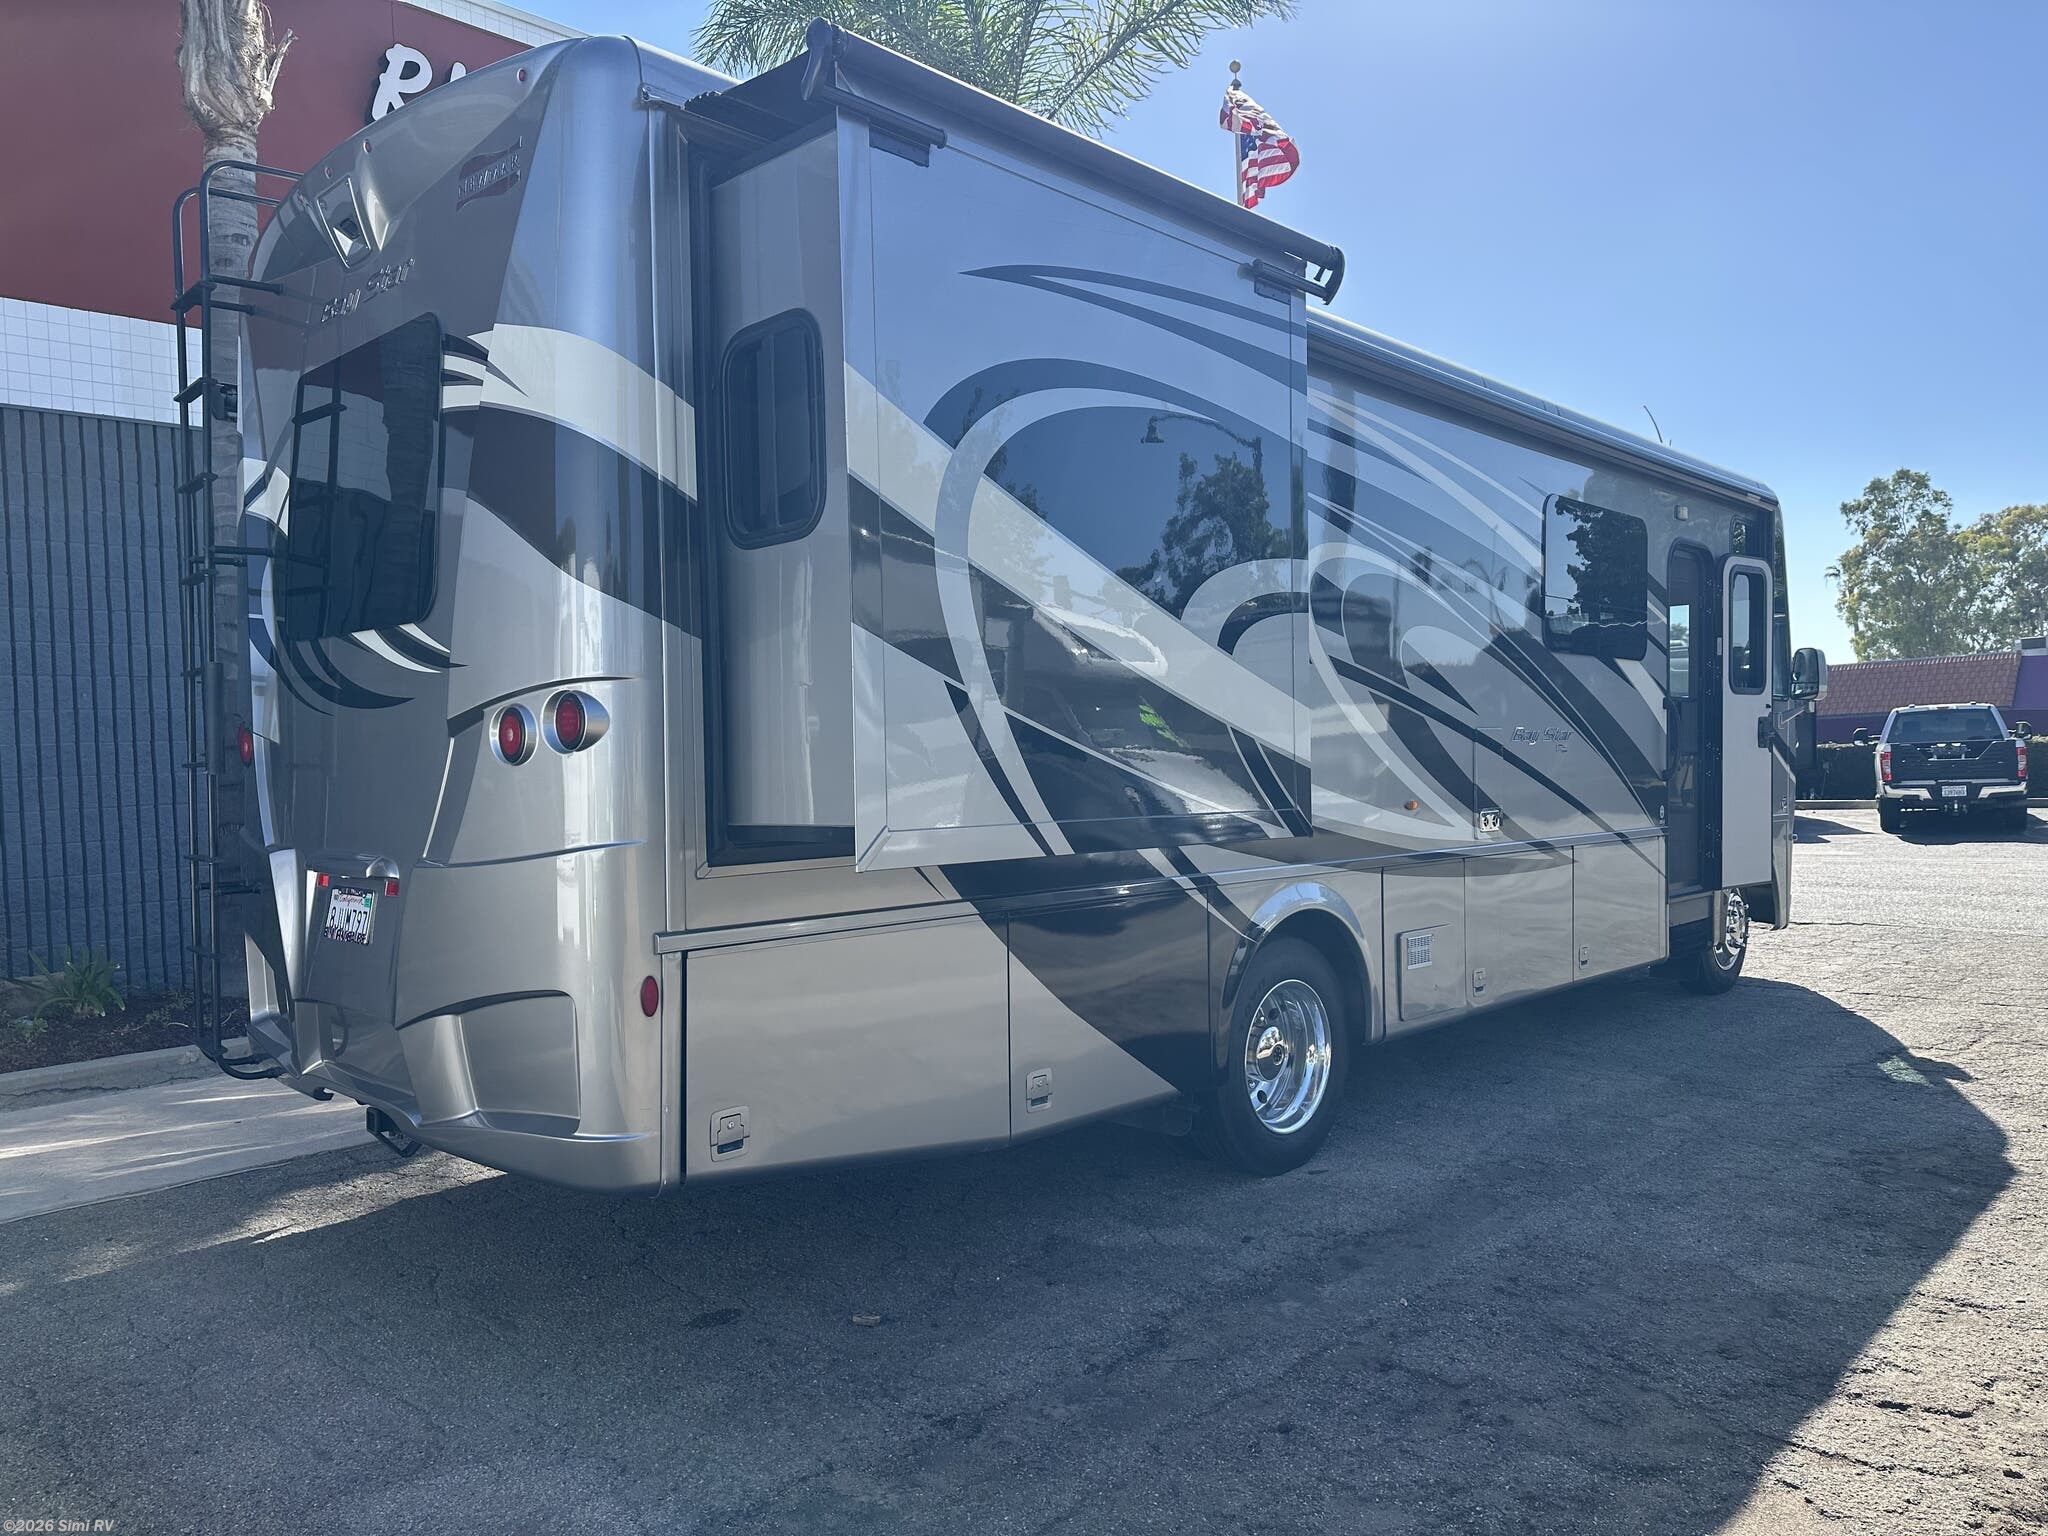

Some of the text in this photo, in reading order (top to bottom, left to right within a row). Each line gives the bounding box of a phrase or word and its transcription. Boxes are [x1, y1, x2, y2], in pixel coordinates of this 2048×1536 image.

[321, 257, 416, 323] Bay Star
[1512, 726, 1574, 746] Bay Star
